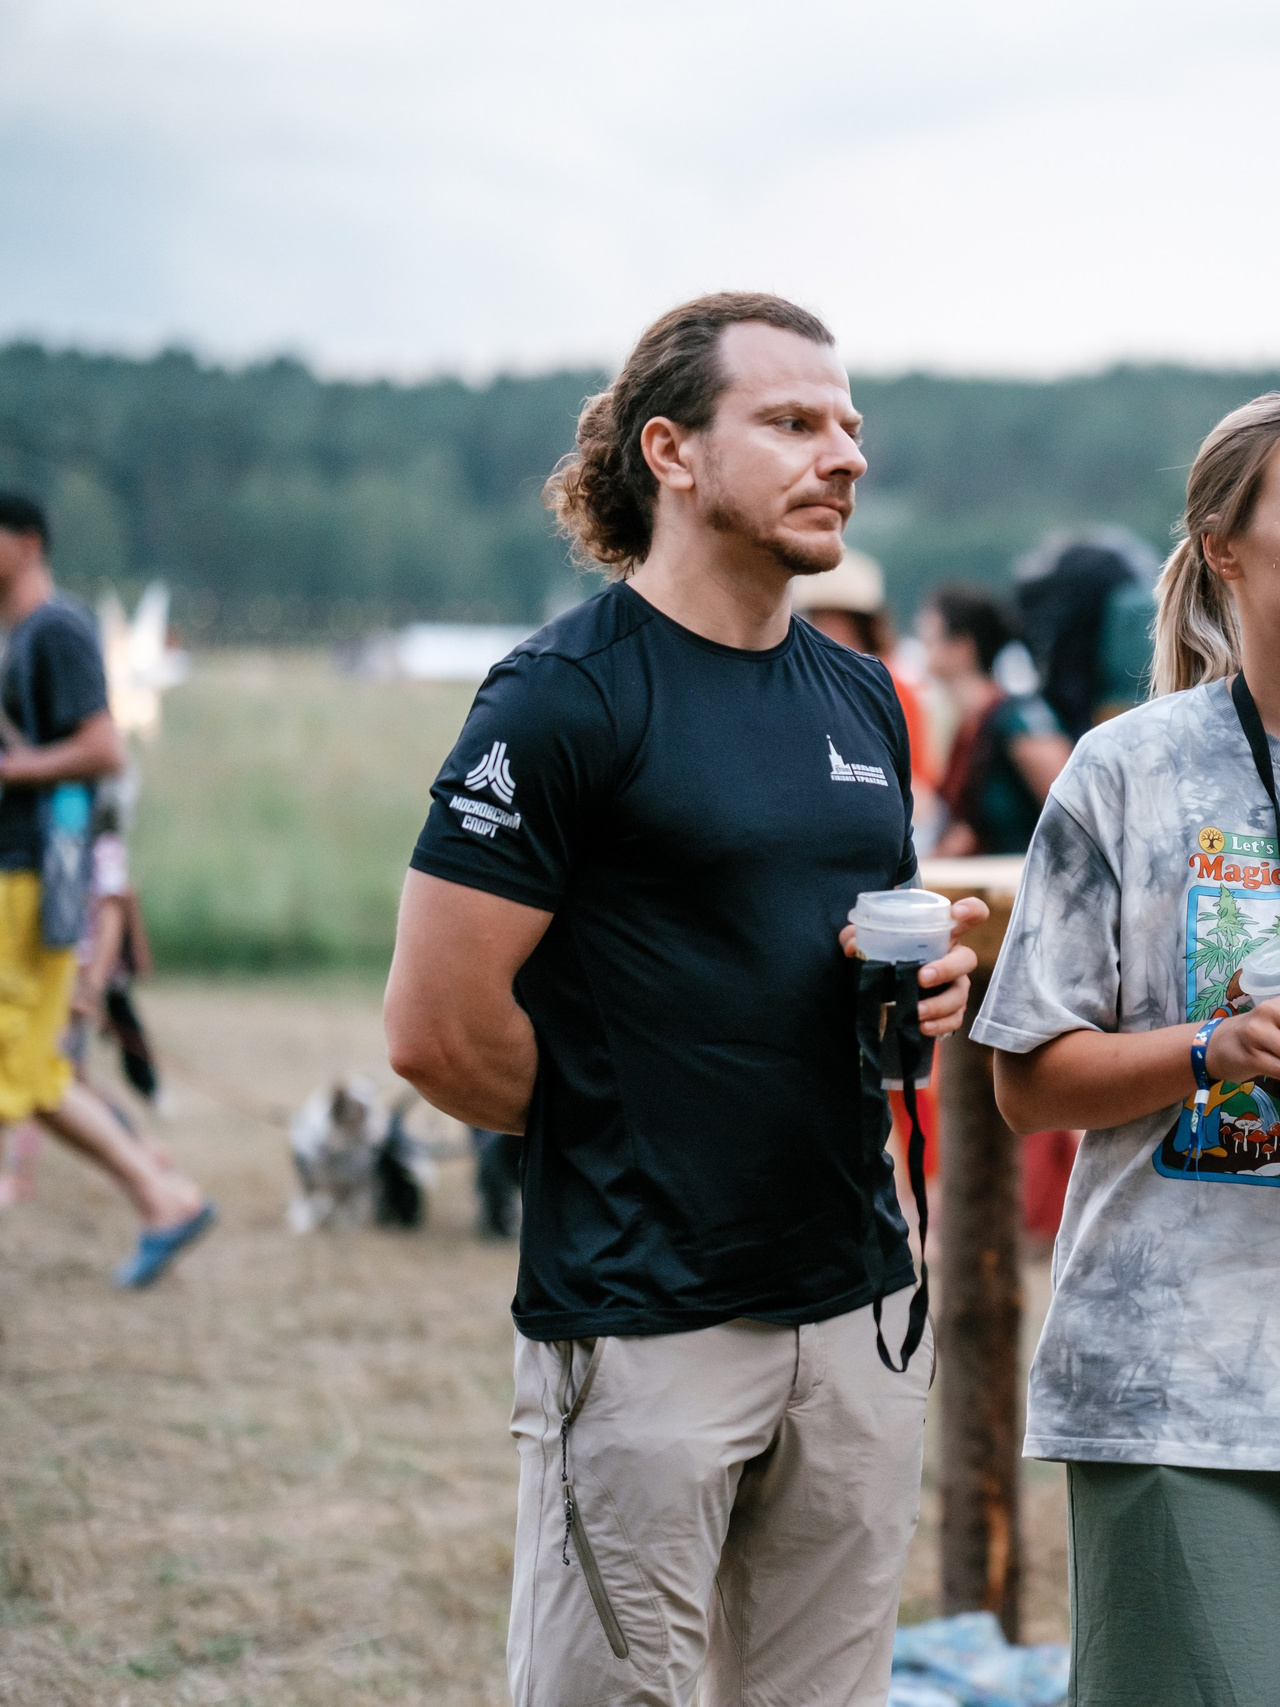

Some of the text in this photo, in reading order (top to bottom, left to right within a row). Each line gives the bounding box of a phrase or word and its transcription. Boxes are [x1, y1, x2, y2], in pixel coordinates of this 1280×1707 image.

[449, 795, 521, 830] МОСКОВСКИЙ
[461, 814, 499, 838] СПОРТ
[1231, 836, 1274, 855] Let's
